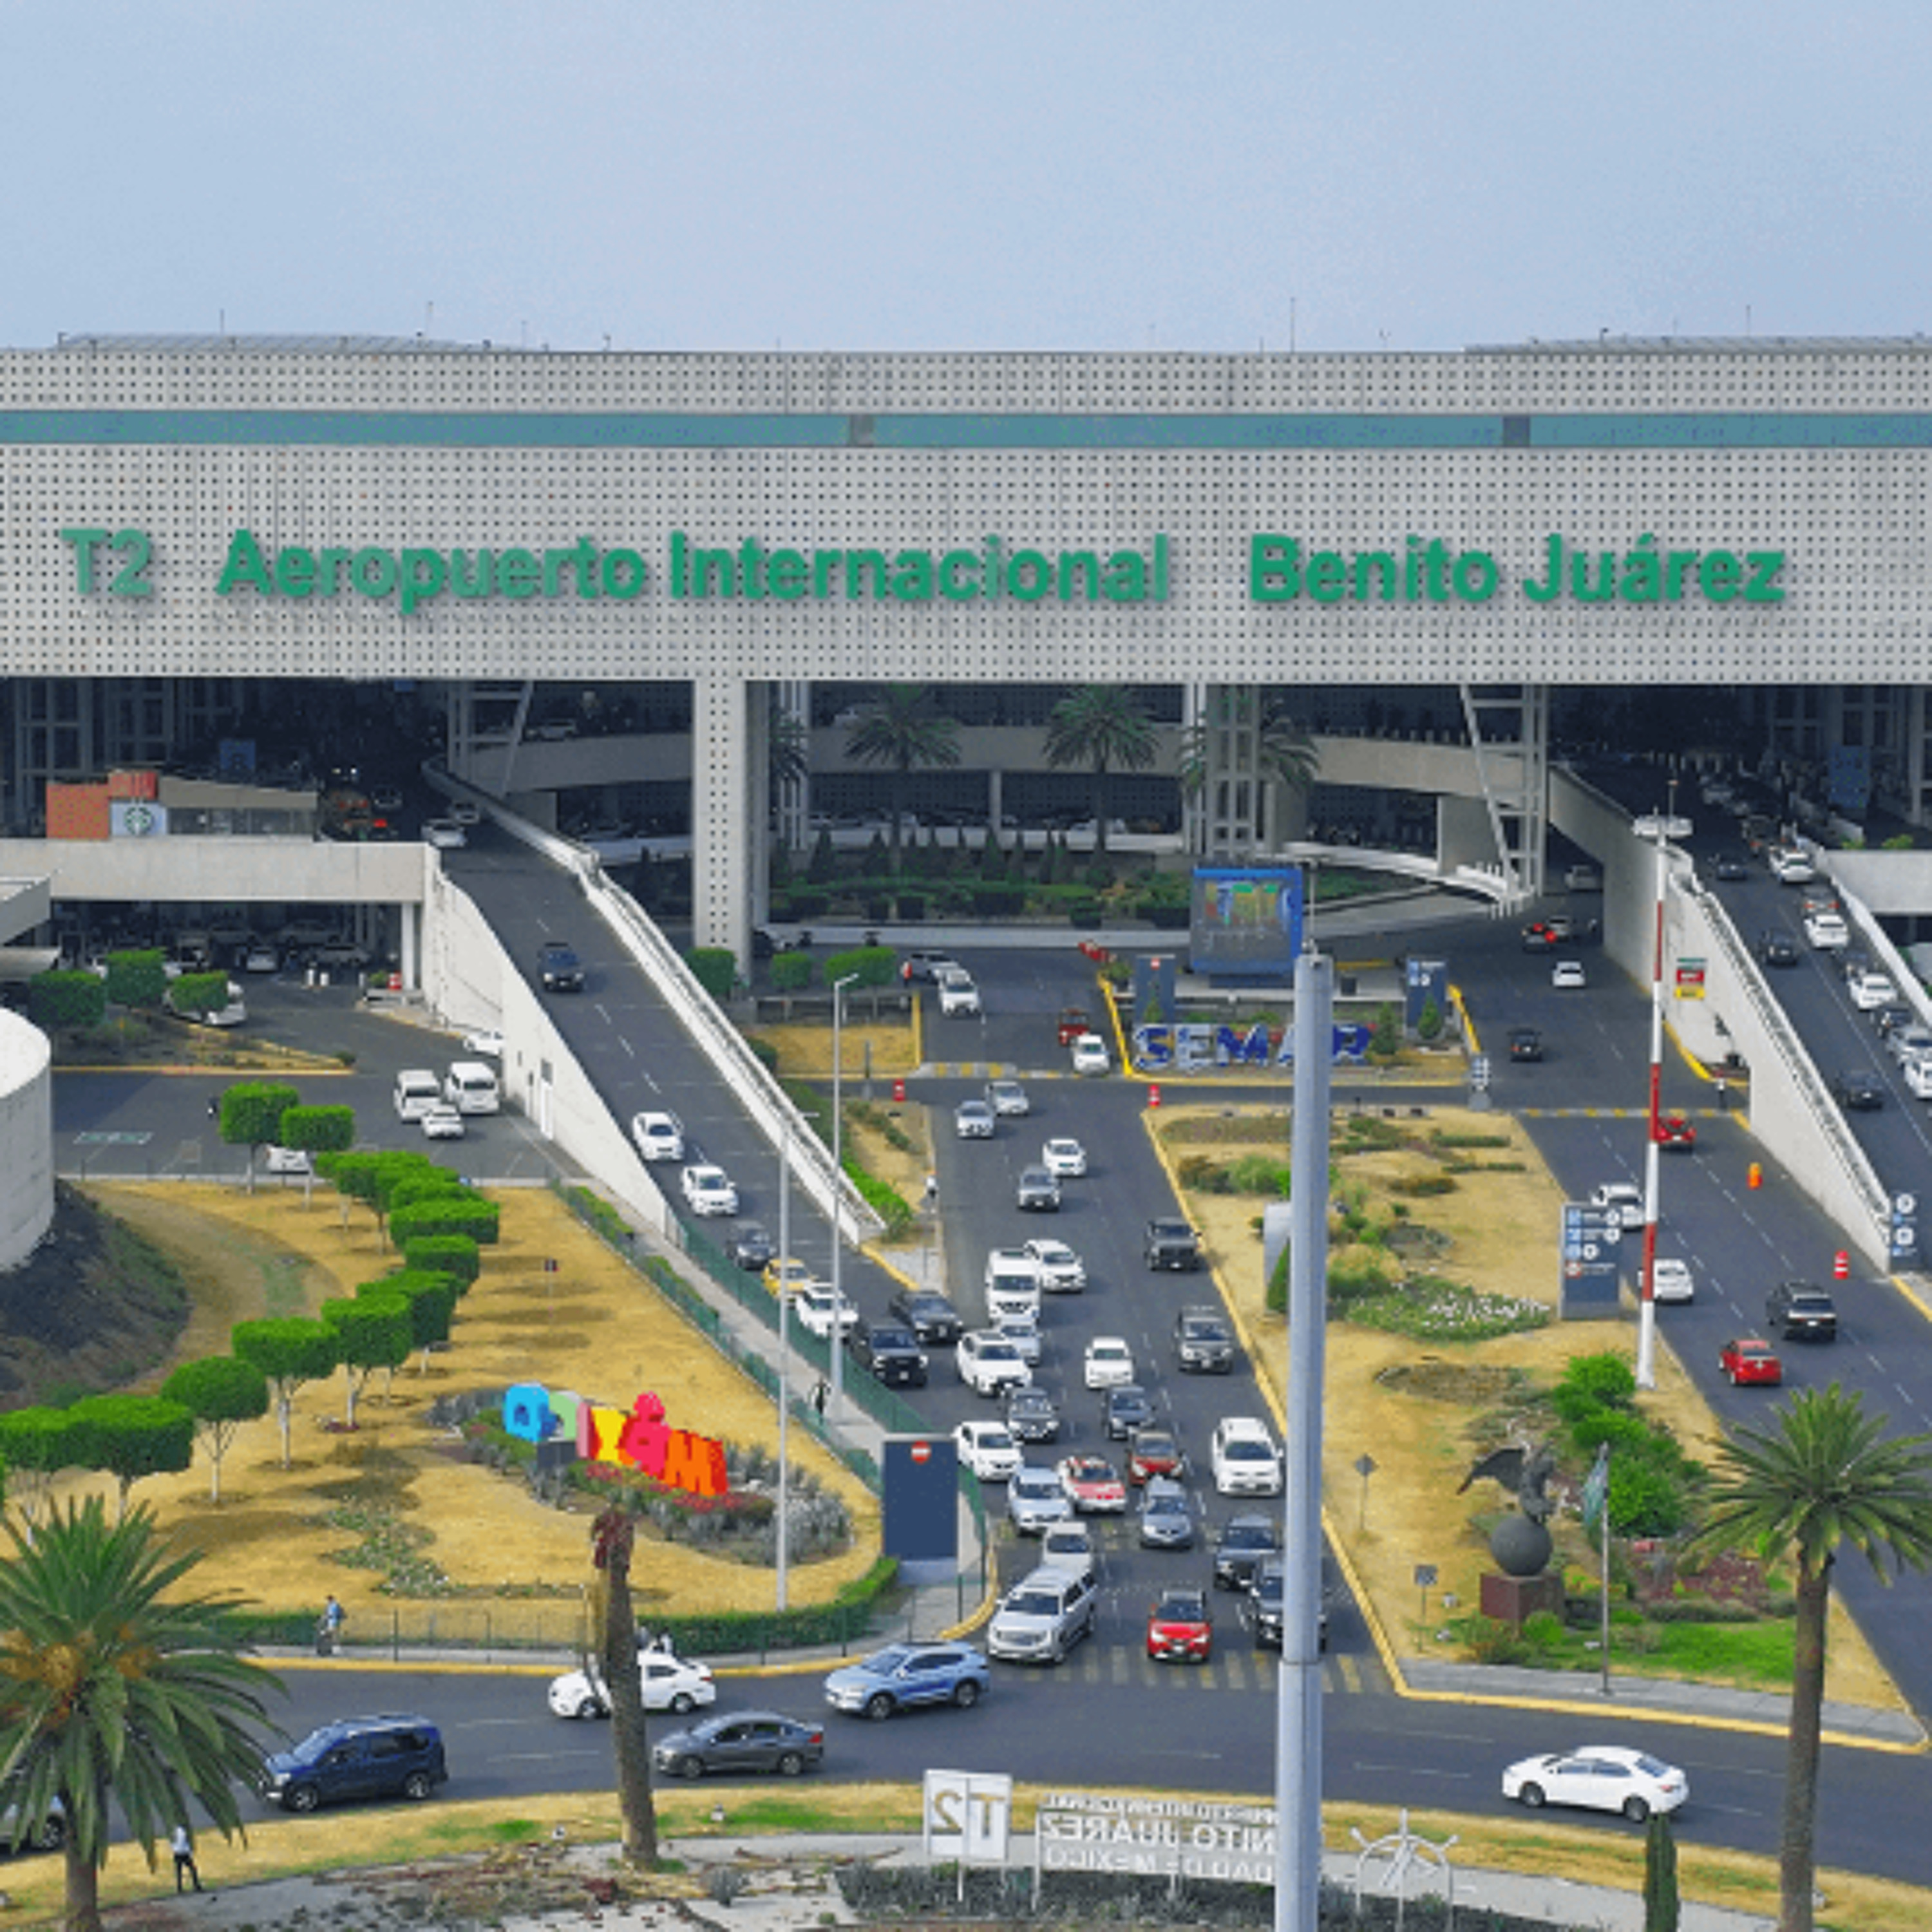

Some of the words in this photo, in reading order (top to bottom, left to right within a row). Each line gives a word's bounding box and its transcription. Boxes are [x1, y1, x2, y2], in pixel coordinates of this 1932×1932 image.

[61, 528, 151, 595] T2
[215, 528, 647, 616] Aeropuerto
[670, 531, 1169, 603] Internacional
[1249, 533, 1501, 604] Benito
[1522, 532, 1786, 603] Juárez
